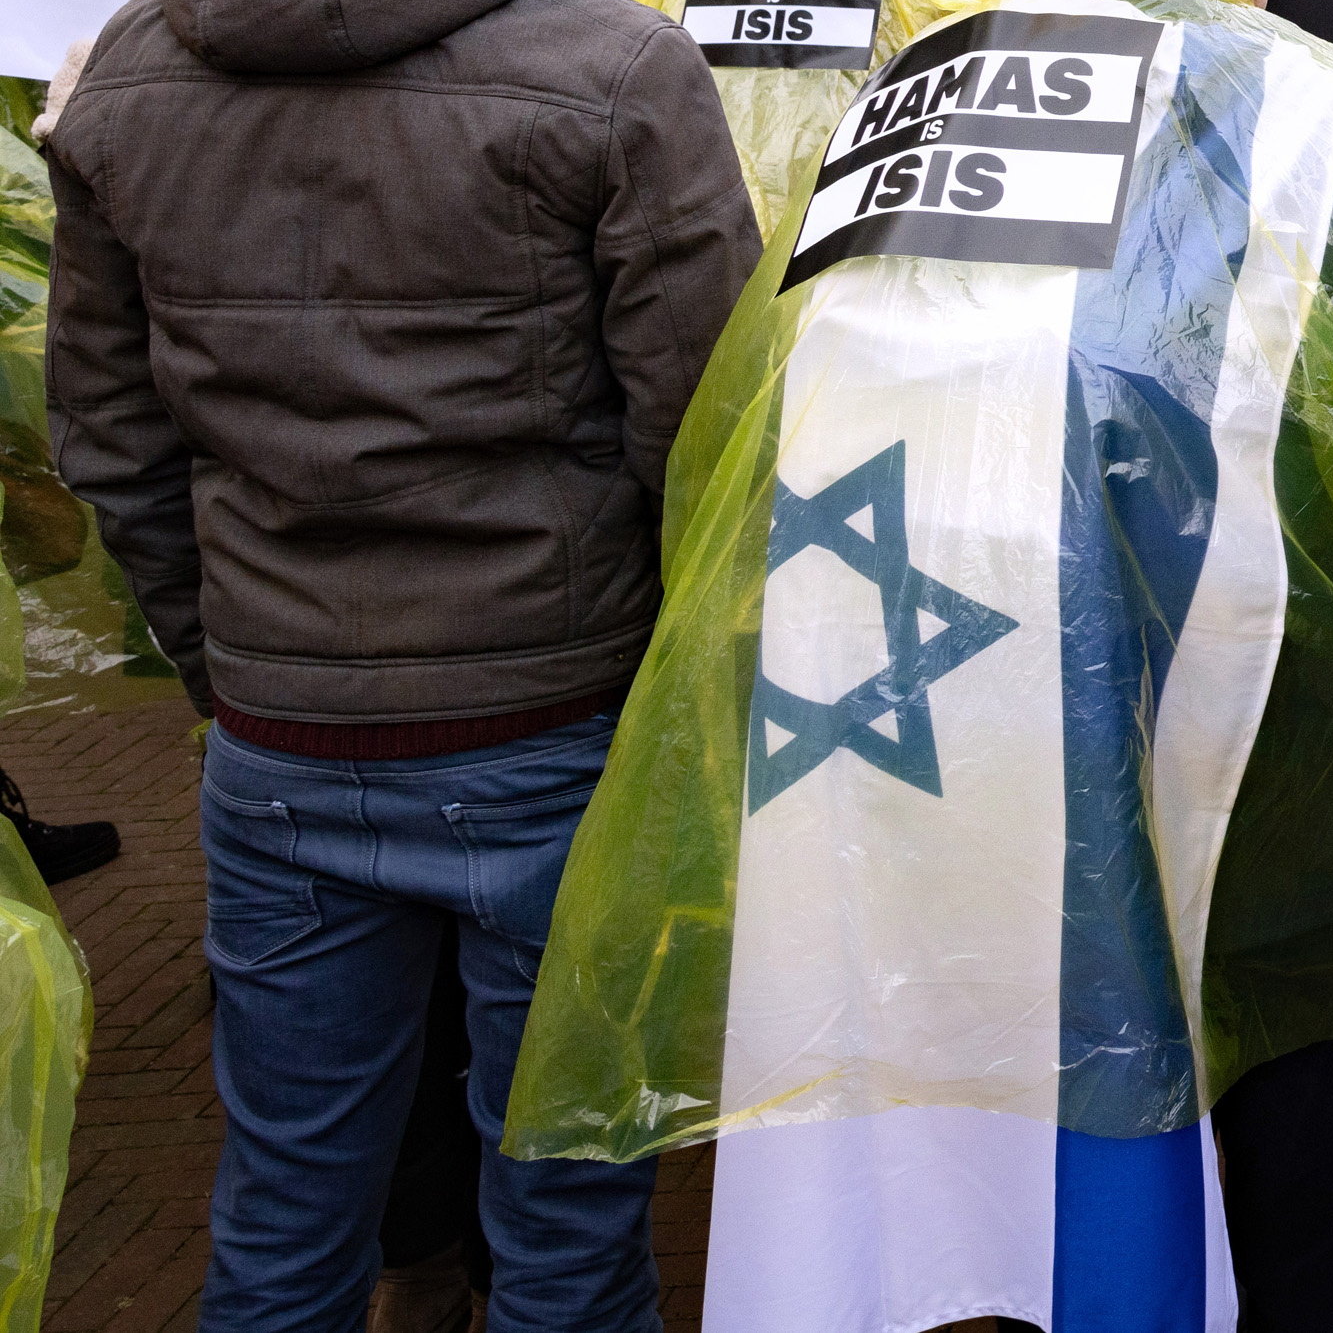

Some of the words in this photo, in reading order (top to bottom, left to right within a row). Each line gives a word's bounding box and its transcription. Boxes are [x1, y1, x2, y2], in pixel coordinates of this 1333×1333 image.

[731, 9, 814, 42] ISIS
[850, 55, 1092, 149] HAMAS
[920, 120, 943, 142] IS
[854, 150, 1008, 218] ISIS
